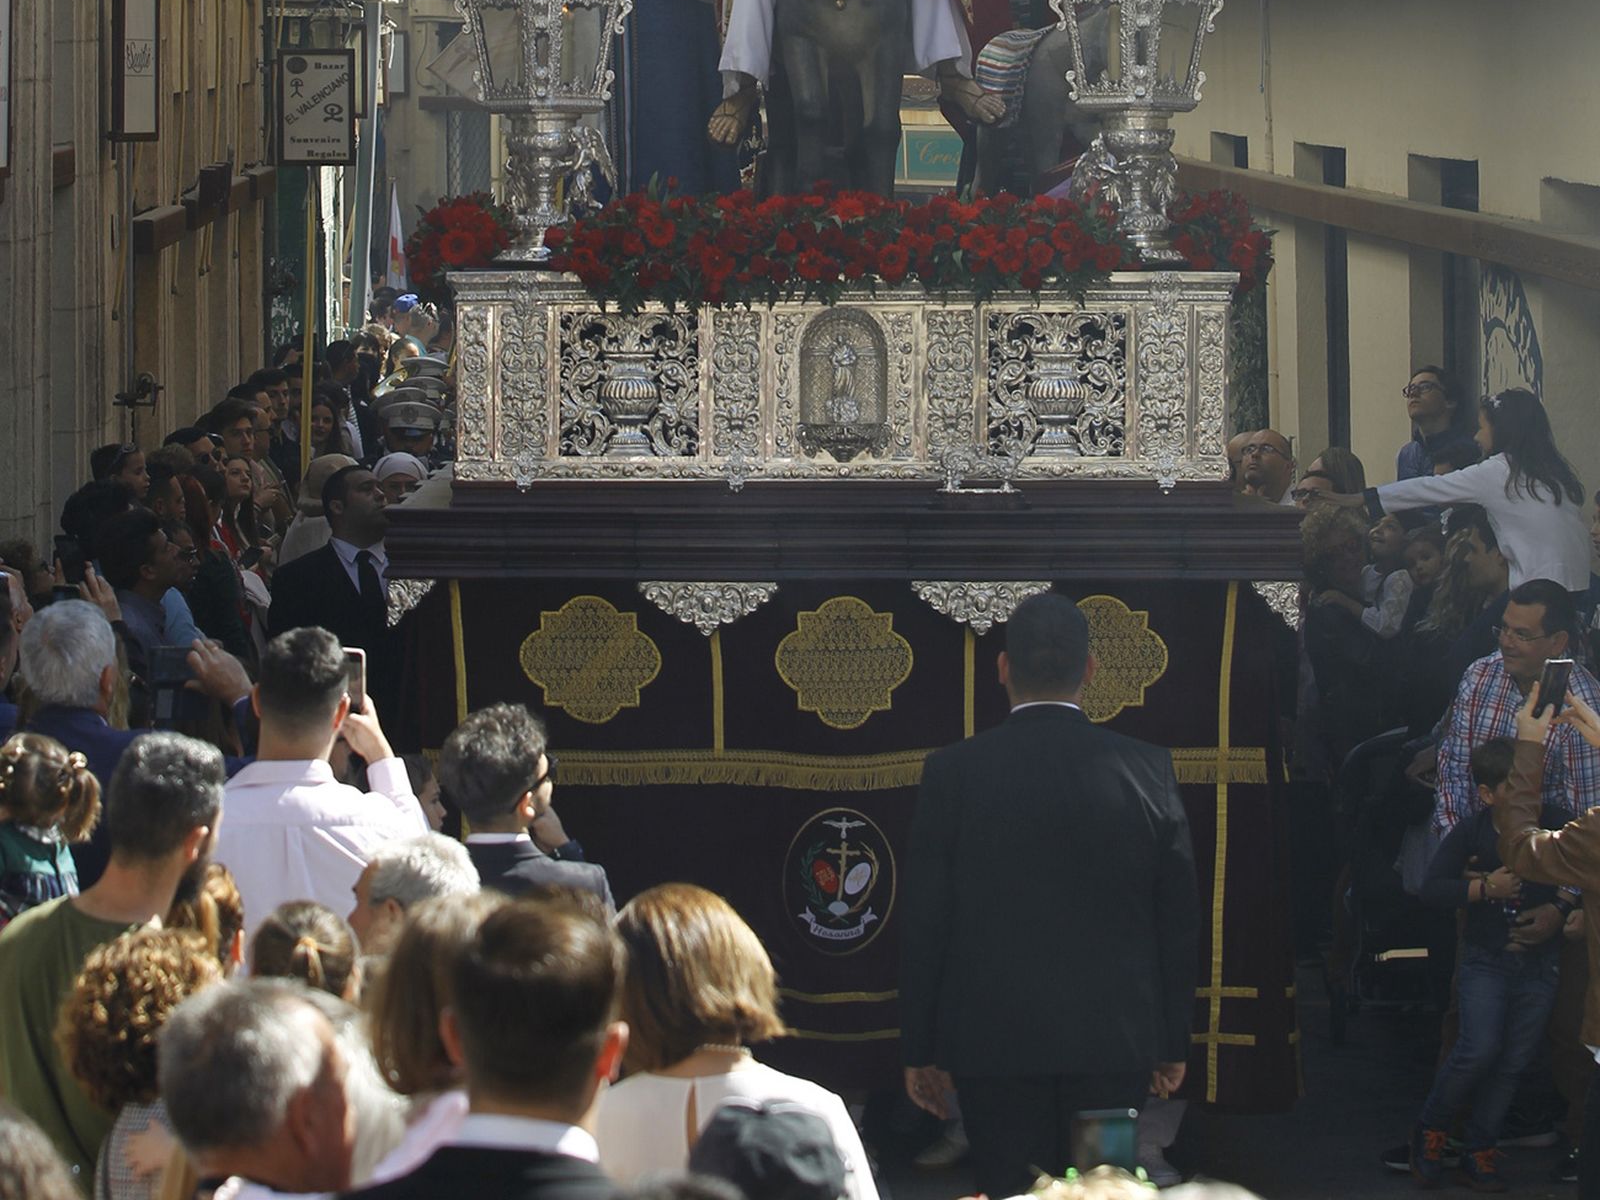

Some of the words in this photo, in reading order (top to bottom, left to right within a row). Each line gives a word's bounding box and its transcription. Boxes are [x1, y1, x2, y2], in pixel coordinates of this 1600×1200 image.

[315, 62, 345, 70] Bazar
[285, 112, 299, 125] EL
[296, 72, 350, 115] VALENCIANO
[307, 150, 347, 159] Regalos
